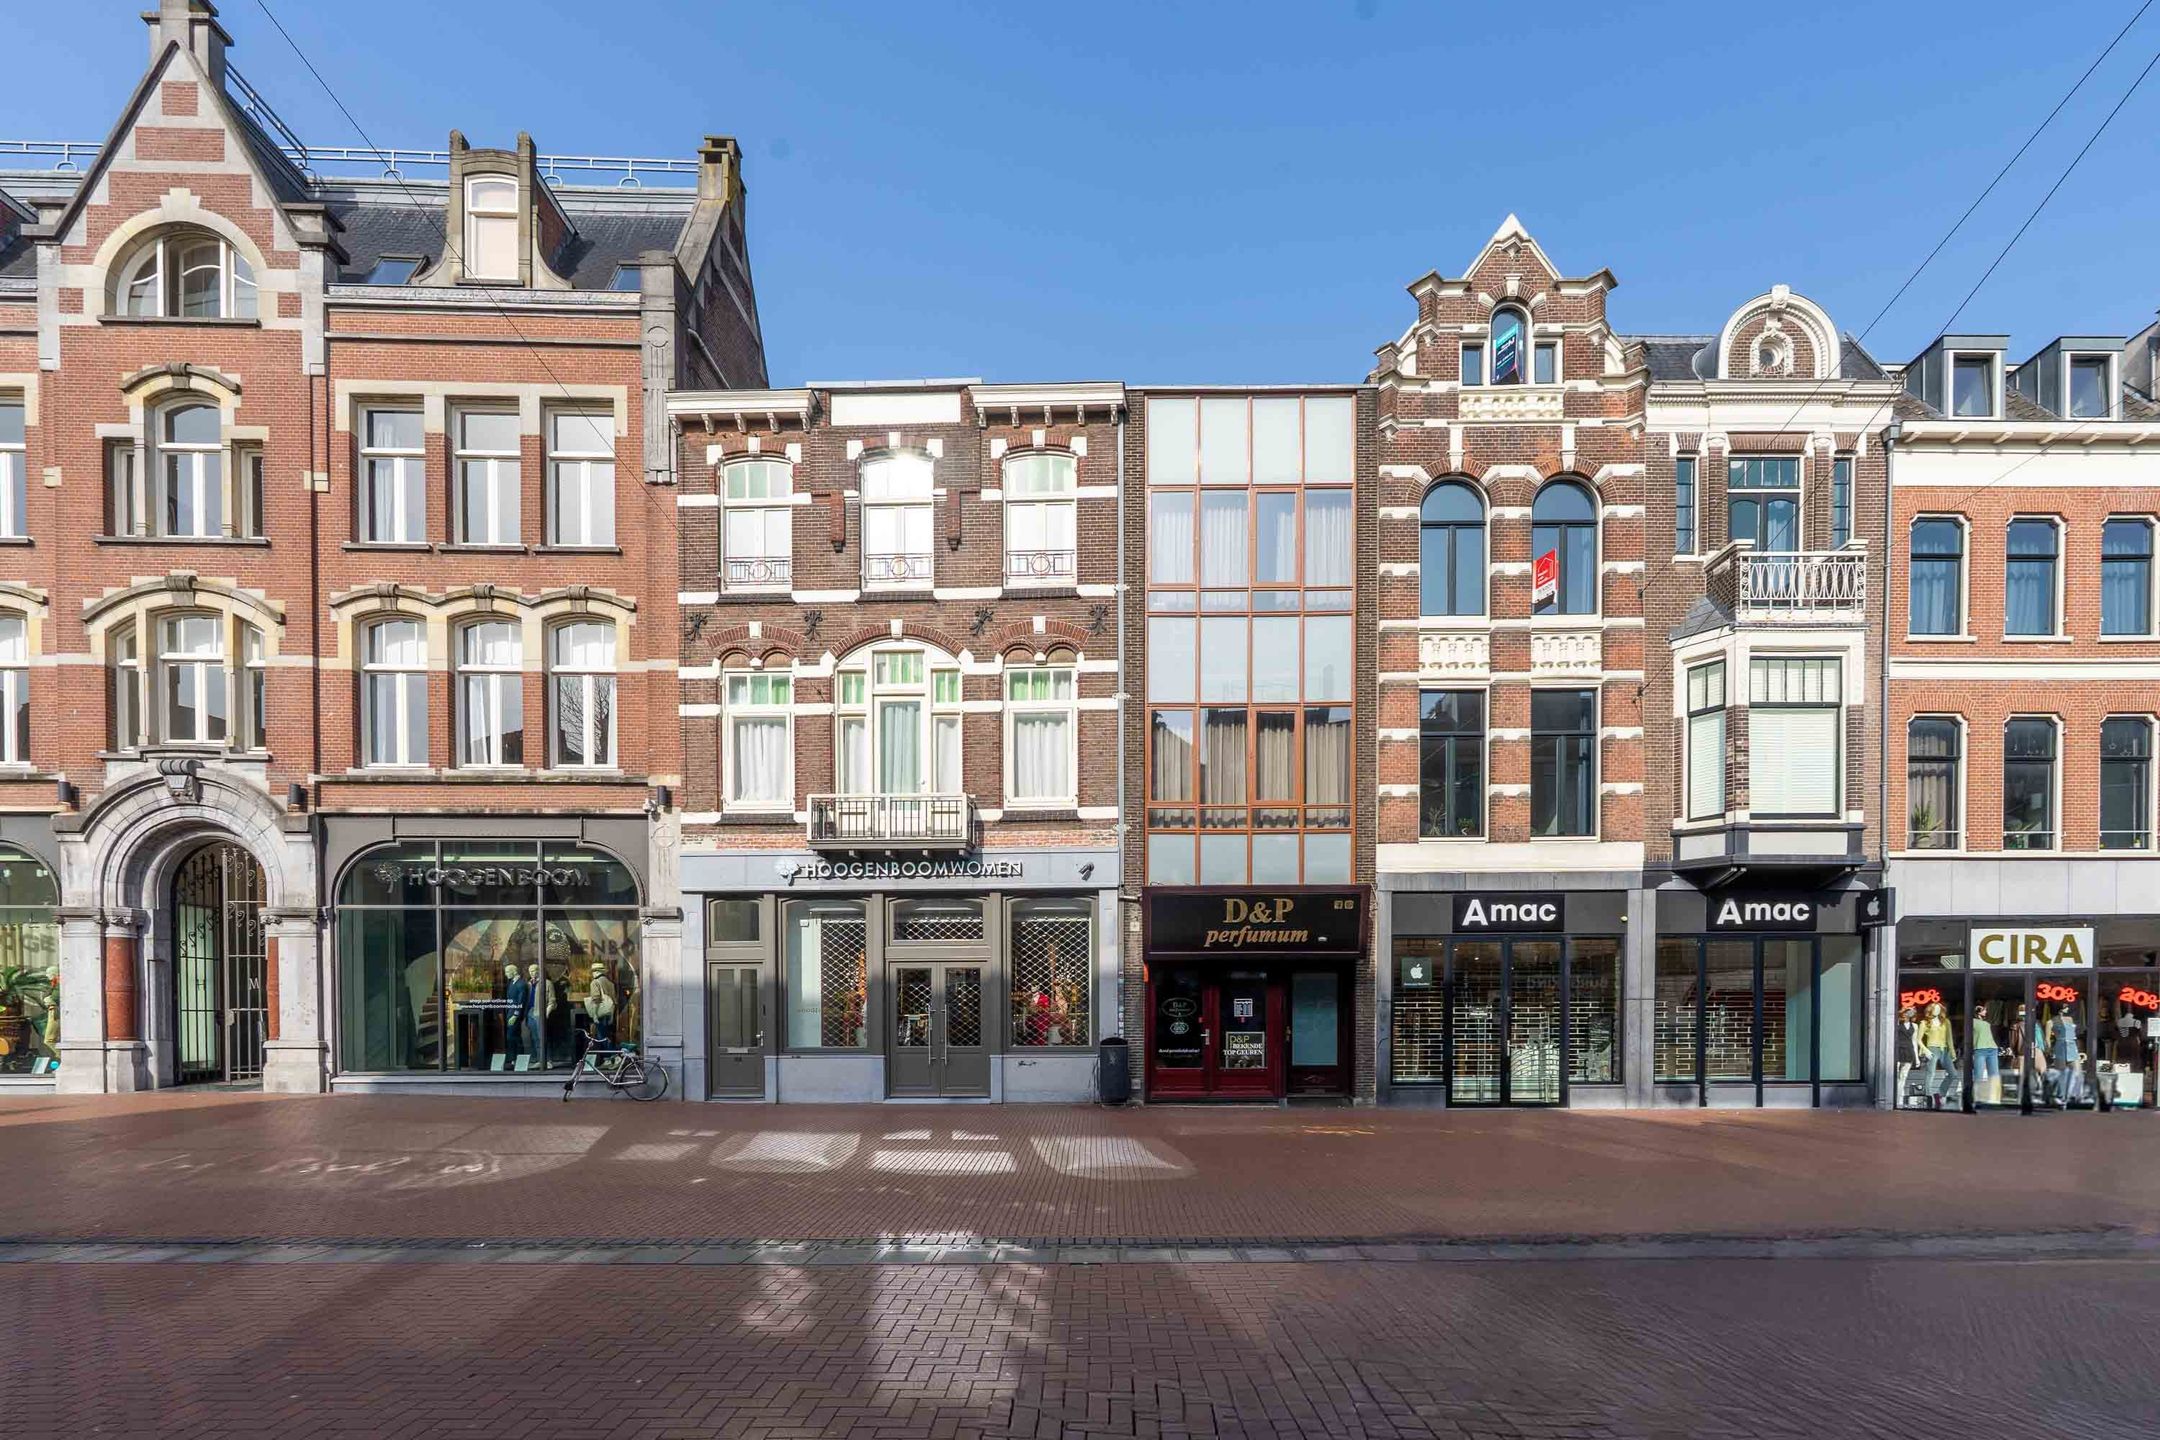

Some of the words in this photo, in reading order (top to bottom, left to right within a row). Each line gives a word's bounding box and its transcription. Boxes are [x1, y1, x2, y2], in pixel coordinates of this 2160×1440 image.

[408, 867, 591, 886] HOOGENBOOM
[805, 861, 1023, 877] HOOGENBOOMWOMEN
[1223, 898, 1294, 923] D&P
[1462, 899, 1556, 926] Amac
[1716, 898, 1810, 925] Amac
[1204, 925, 1309, 947] perfumum
[1978, 934, 2083, 964] CIRA
[1900, 988, 1941, 1007] 50%
[2036, 983, 2079, 1002] 30%
[2119, 986, 2160, 1010] 20%
